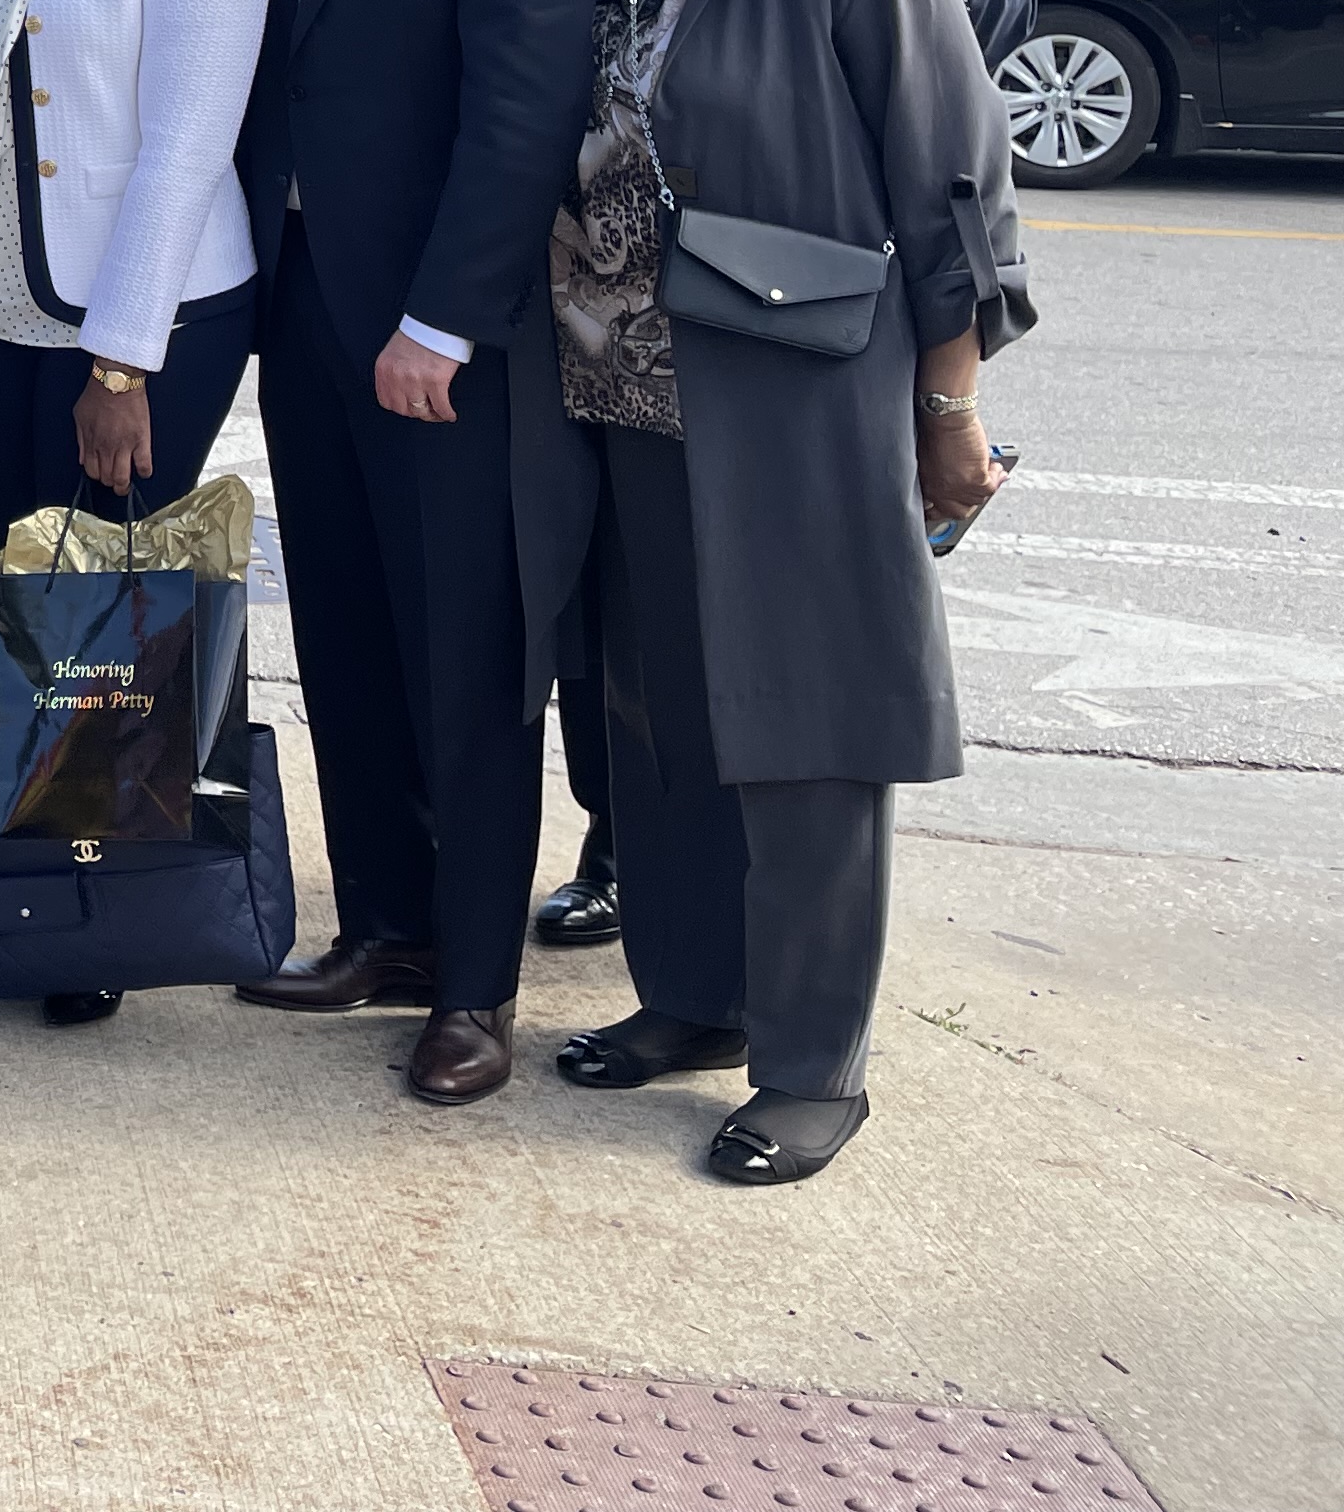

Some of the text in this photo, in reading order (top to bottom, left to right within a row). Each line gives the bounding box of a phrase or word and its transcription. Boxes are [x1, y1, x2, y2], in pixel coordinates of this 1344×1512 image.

[52, 656, 135, 686] Honoring
[33, 687, 155, 718] Herman Petty
